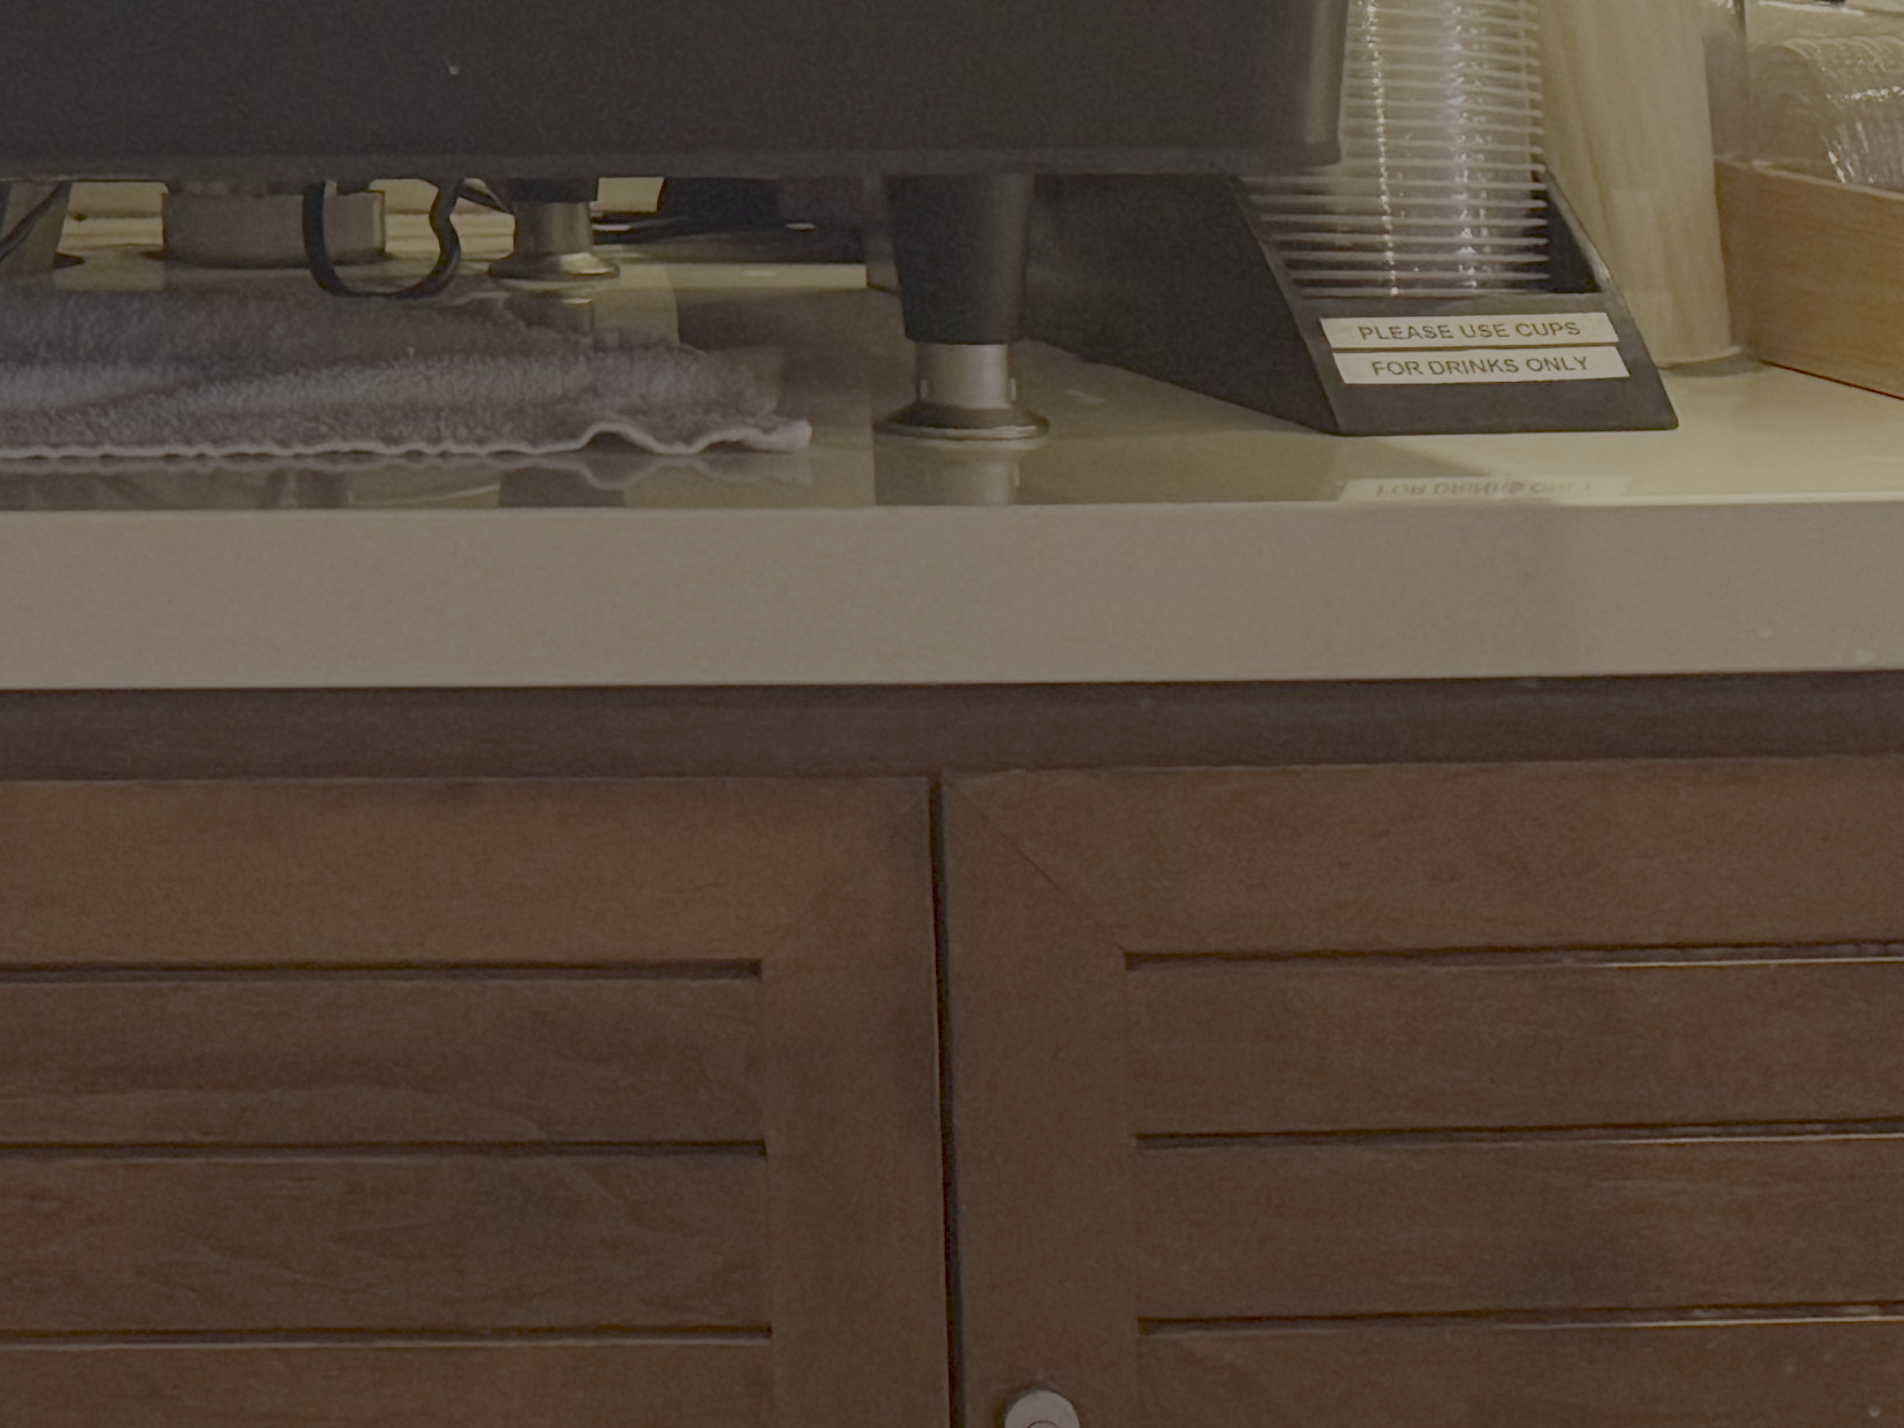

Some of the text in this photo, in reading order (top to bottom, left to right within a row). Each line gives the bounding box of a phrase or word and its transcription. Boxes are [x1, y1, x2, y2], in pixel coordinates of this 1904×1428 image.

[1357, 321, 1582, 342] PLEASE USE CUPS
[1371, 355, 1590, 377] FOR DRINKS ONLY
